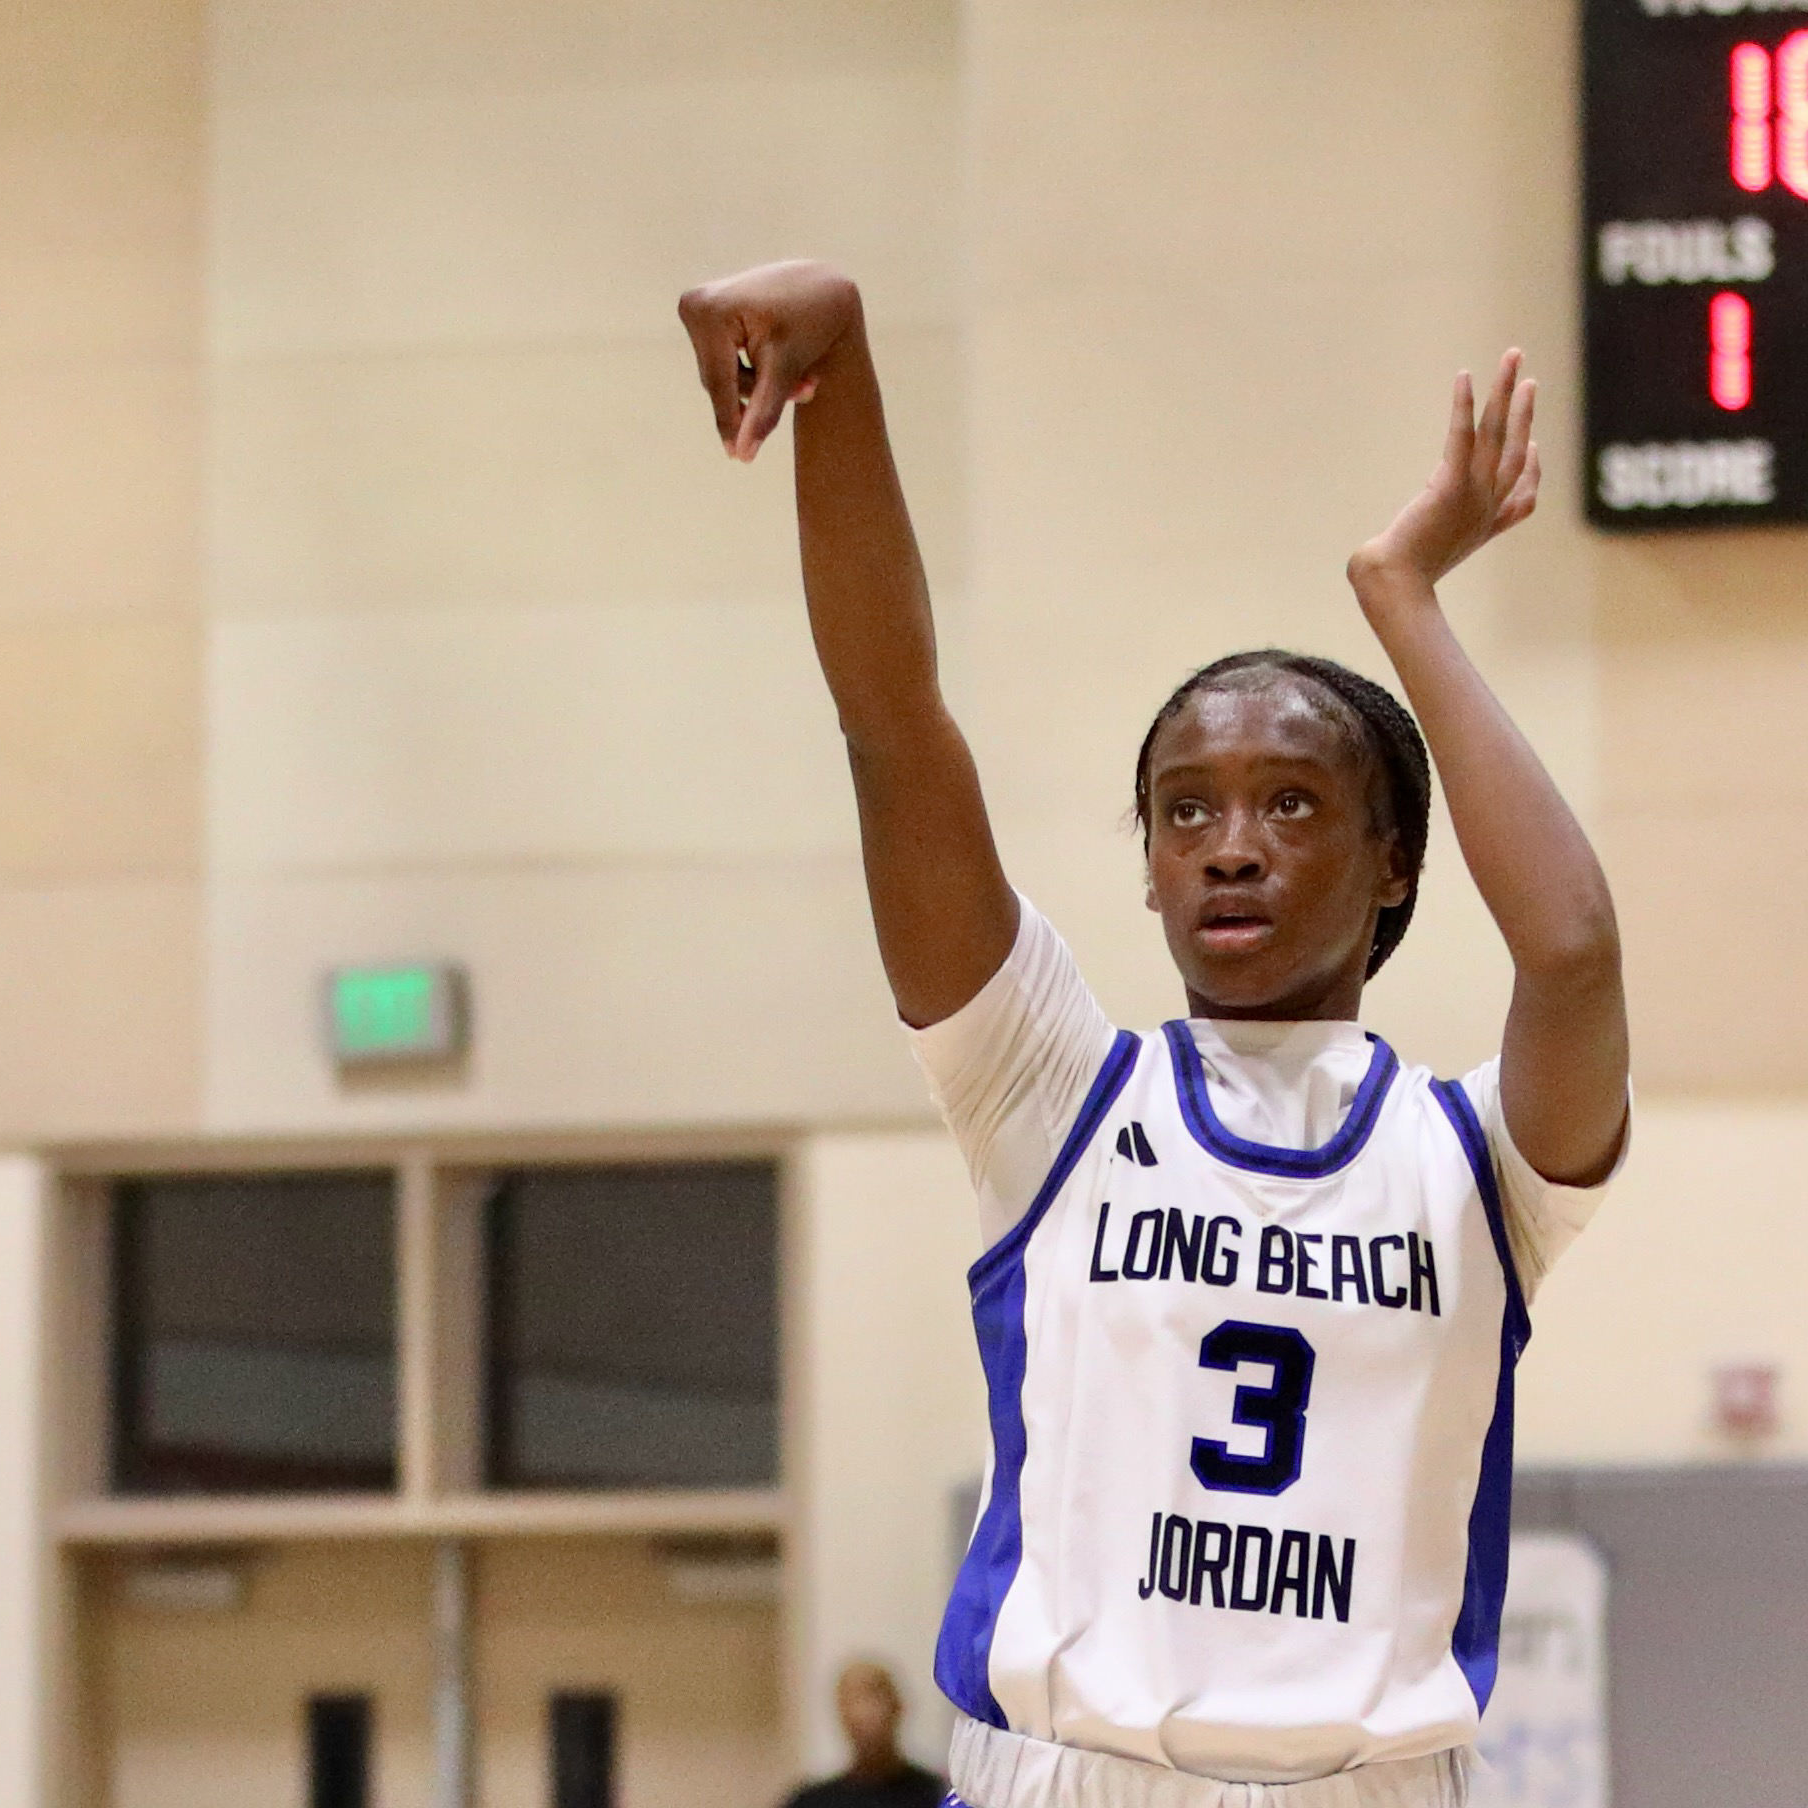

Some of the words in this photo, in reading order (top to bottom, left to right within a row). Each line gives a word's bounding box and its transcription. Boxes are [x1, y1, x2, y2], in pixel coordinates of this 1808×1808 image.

[1599, 218, 1774, 286] FOULS
[1709, 291, 1752, 411] 1
[1599, 441, 1776, 509] SCORE
[1089, 1202, 1242, 1287] LONG
[1256, 1224, 1441, 1317] BEACH
[1190, 1319, 1316, 1497] 3
[1139, 1512, 1356, 1622] JORDAN
